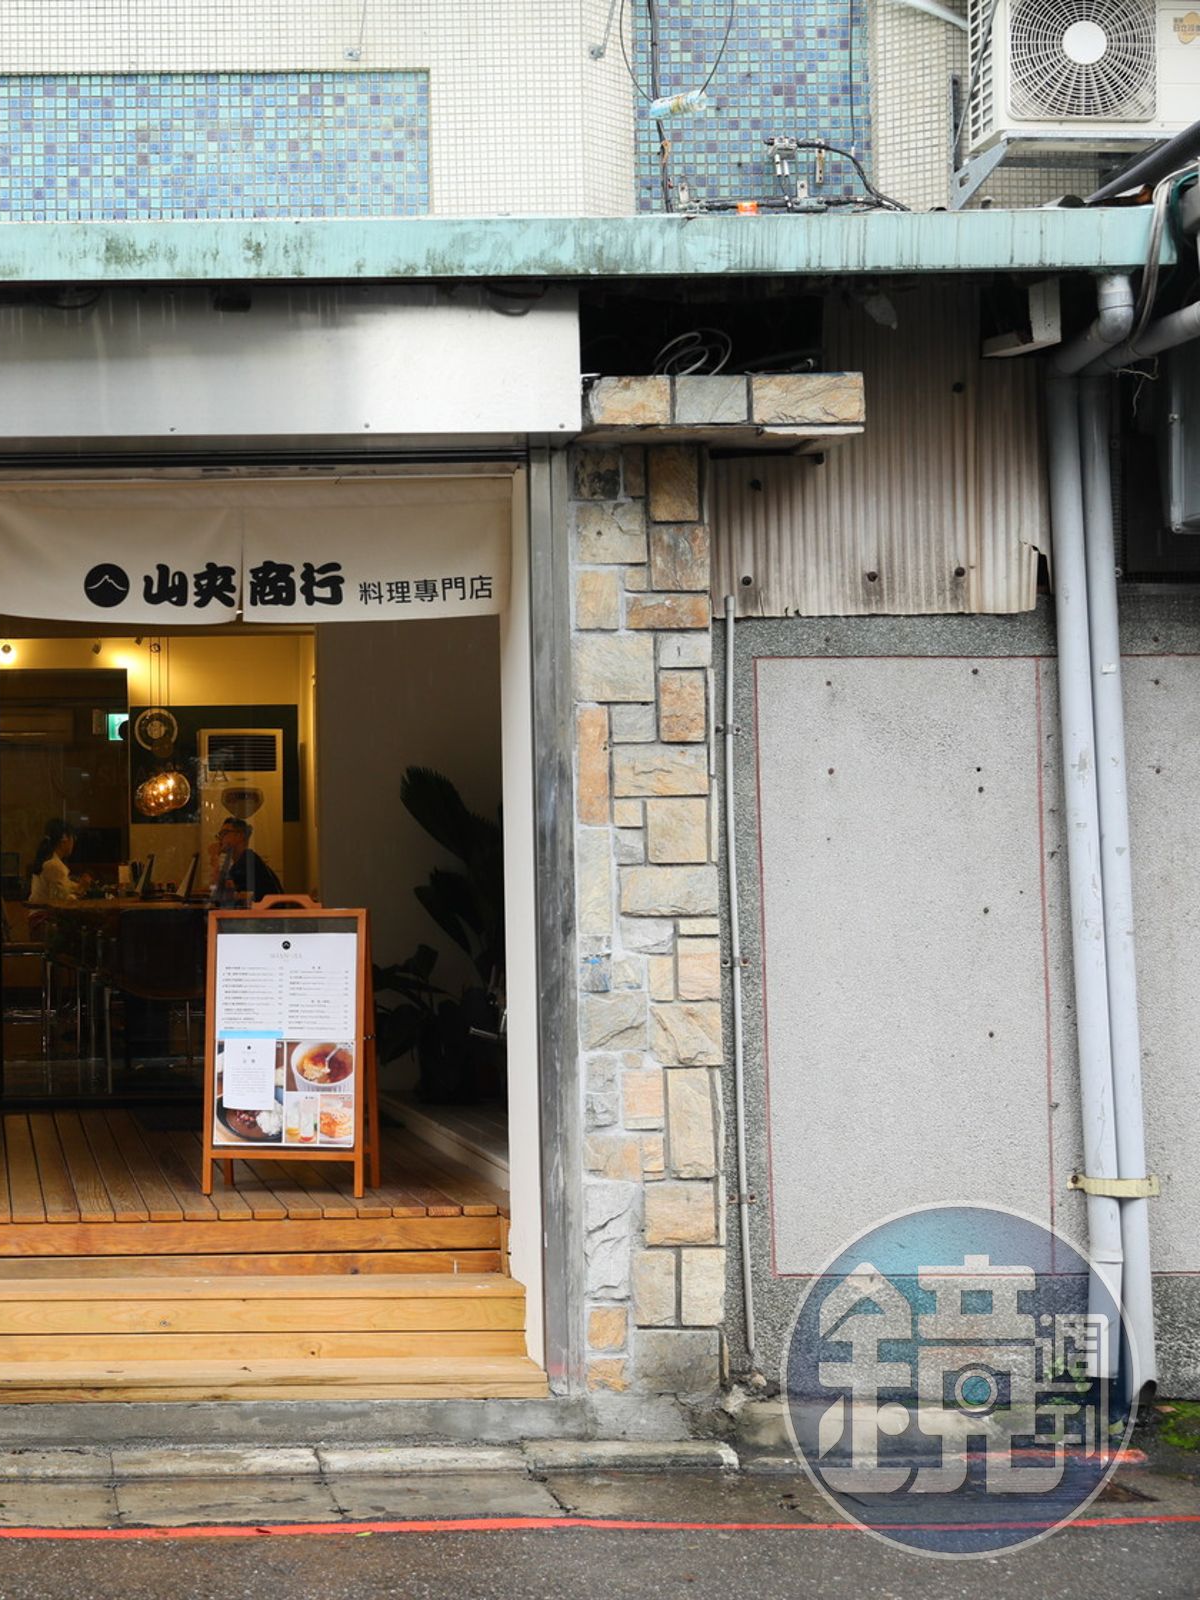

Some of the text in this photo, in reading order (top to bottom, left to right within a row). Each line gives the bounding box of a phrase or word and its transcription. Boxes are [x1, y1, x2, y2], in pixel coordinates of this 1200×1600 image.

[359, 574, 493, 606] 料理專門店
